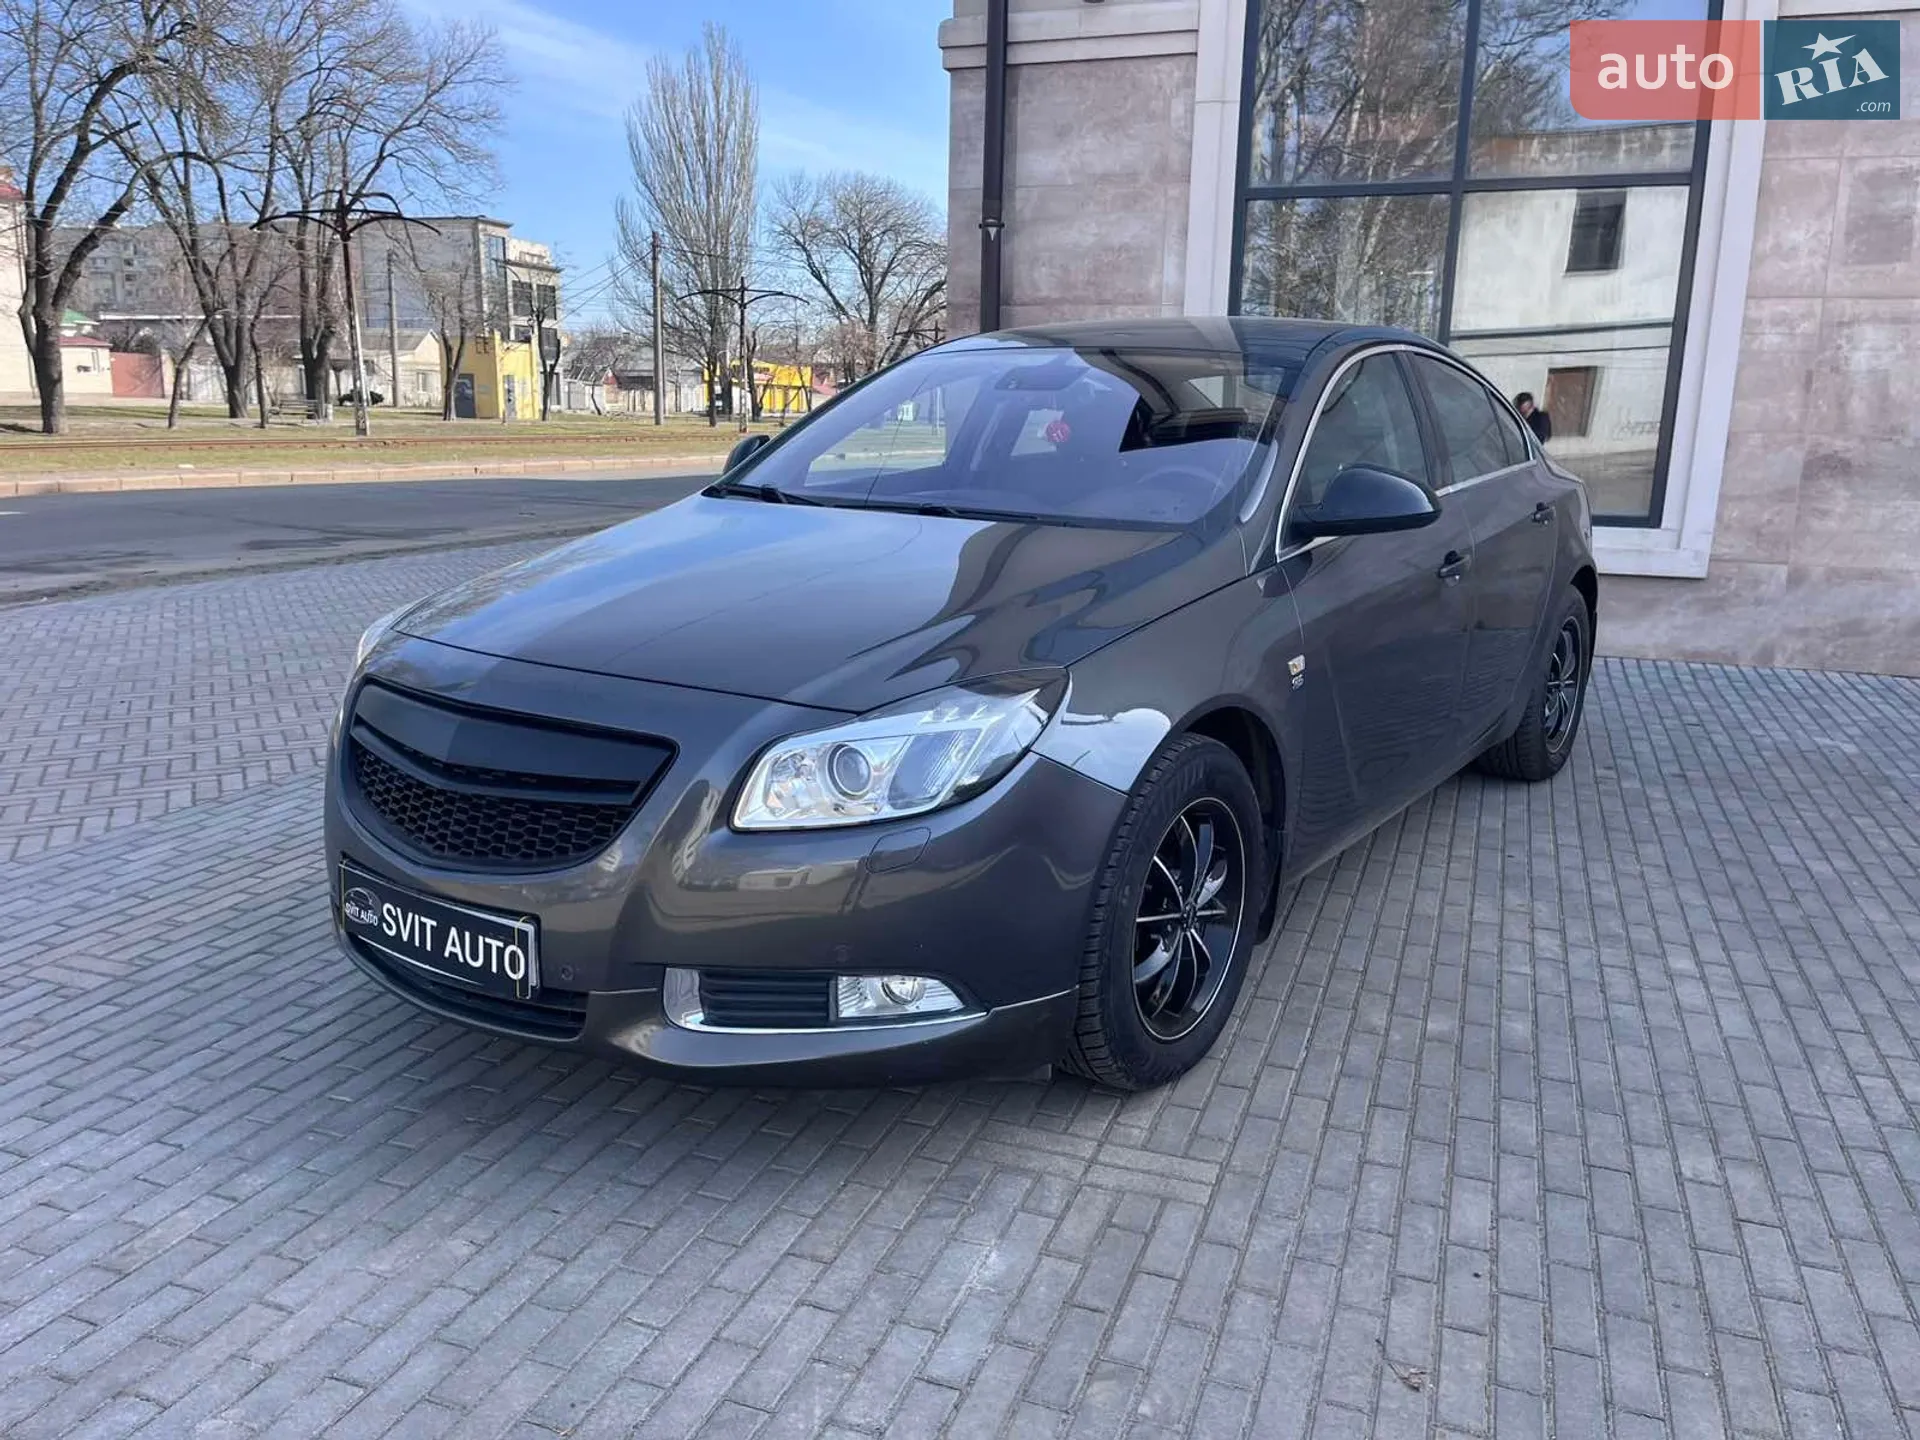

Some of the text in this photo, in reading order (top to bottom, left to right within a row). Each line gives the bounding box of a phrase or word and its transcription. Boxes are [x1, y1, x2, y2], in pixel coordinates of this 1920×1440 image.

[360, 909, 378, 927] AUTO
[382, 902, 526, 981] SVIT AUTO
